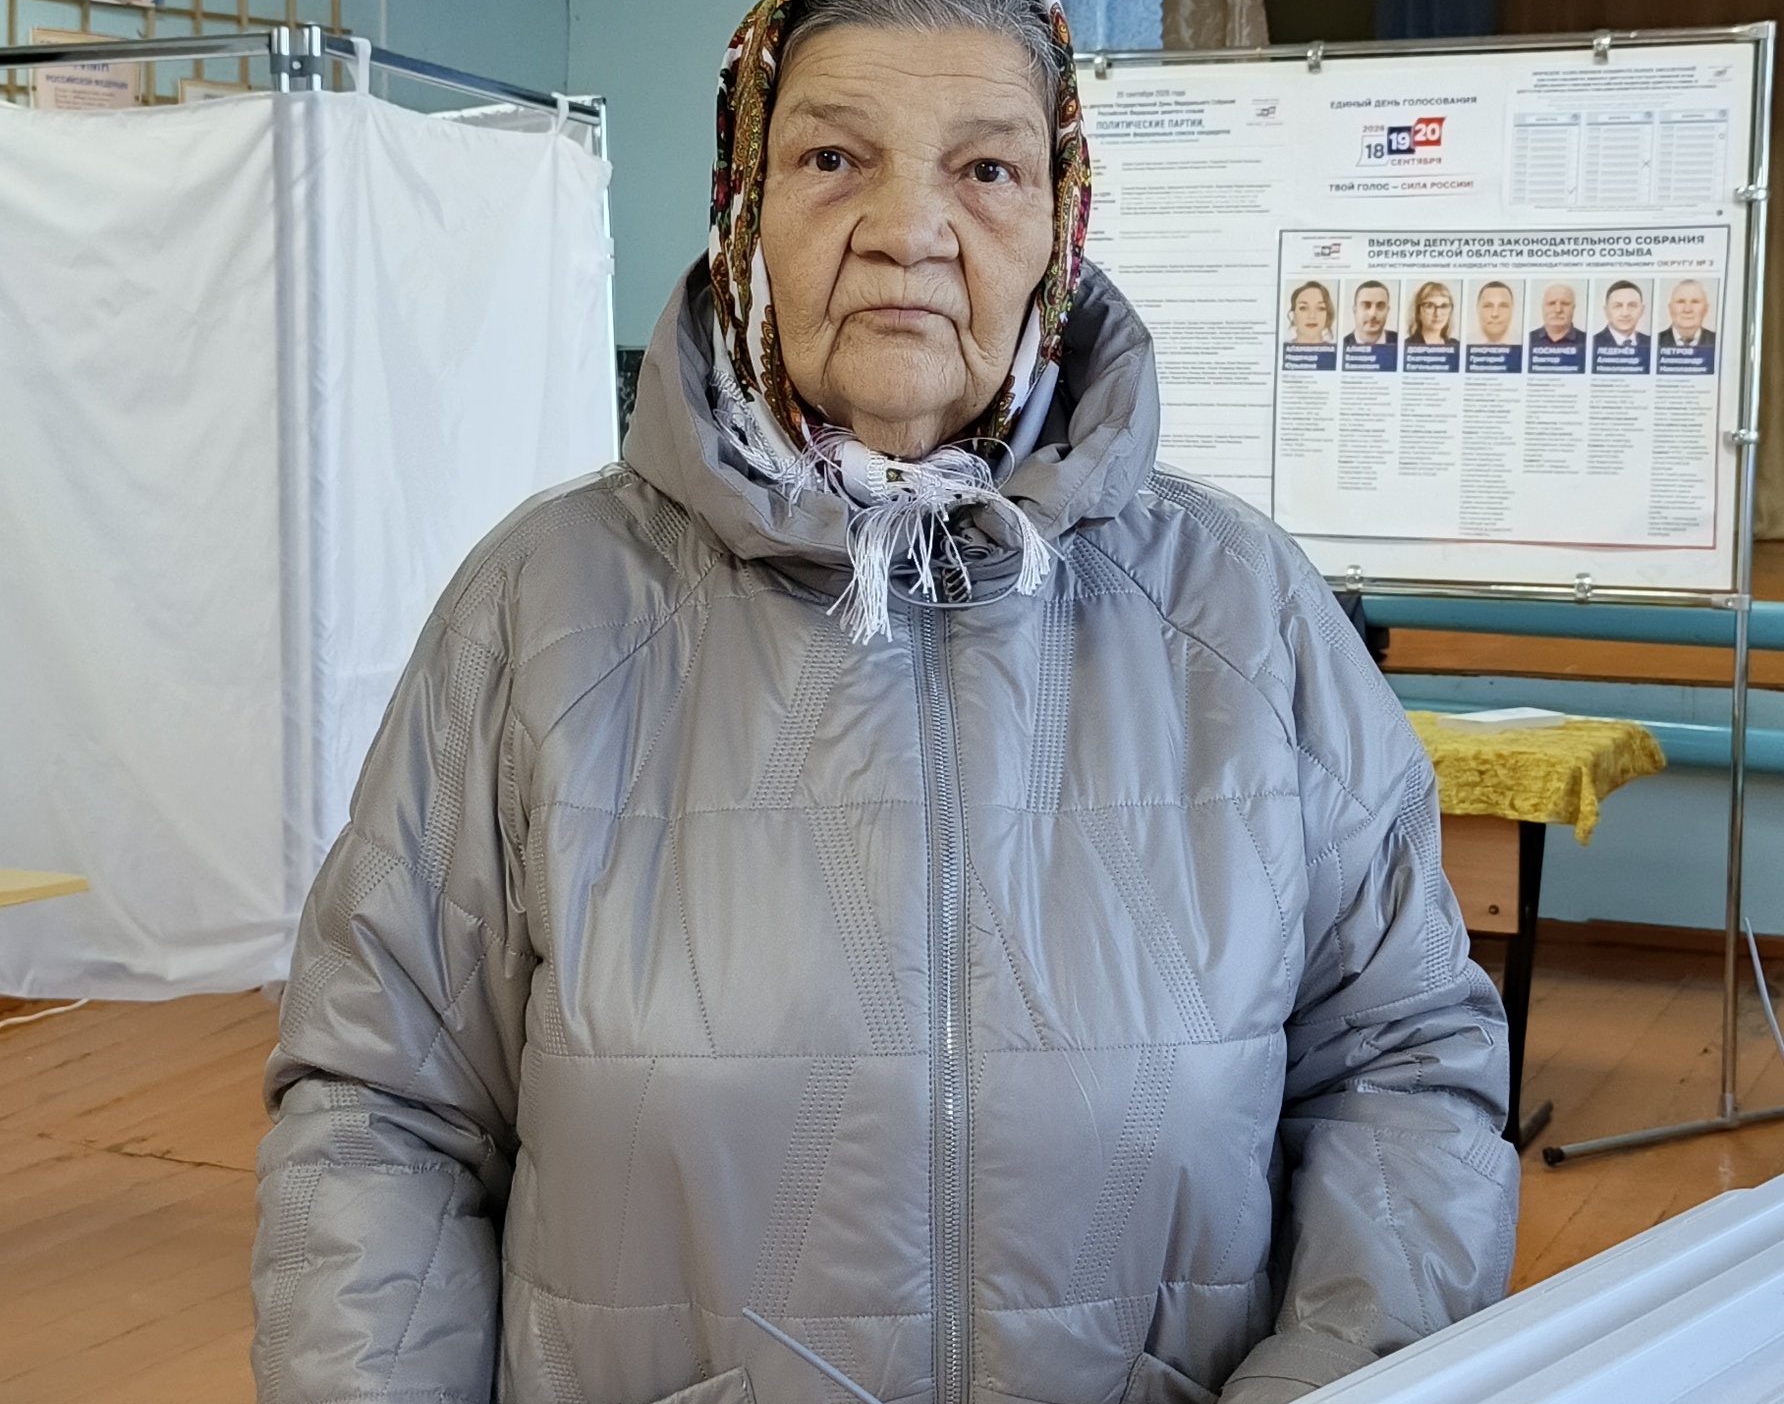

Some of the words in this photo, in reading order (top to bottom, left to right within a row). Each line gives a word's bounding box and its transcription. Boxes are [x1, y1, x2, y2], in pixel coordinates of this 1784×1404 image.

[1330, 98, 1371, 109] ЕДИНЫЙ
[1374, 98, 1400, 108] ДЕНЬ
[1403, 96, 1477, 106] ГОЛОСОВАНИЯ
[1096, 119, 1165, 130] ПОЛИТИЧЕСКИЕ
[1168, 118, 1205, 129] ПАРТИИ,
[1365, 144, 1384, 159] 18
[1389, 132, 1410, 150] 19
[1414, 123, 1440, 141] 20
[1391, 158, 1442, 166] СЕНТЯБРЯ
[1329, 182, 1354, 192] ТВОЙ
[1357, 183, 1389, 191] ГОЛОС
[1401, 182, 1427, 190] СИЛА
[1430, 180, 1474, 189] РОССИИ!
[1368, 238, 1420, 247] ВЫБОРЫ
[1423, 238, 1494, 248] ДЕПУТАТОВ
[1498, 236, 1632, 247] ЗАКОНОДАТЕЛЬНОГО
[1635, 235, 1704, 245] СОБРАНИЯ
[1368, 247, 1463, 258] ОРЕНБУРГСКОЙ
[1466, 249, 1524, 258] ОБЛАСТИ
[1527, 248, 1595, 258] ВОСЬМОГО
[1599, 247, 1652, 257] СОЗЫВА
[1660, 347, 1694, 356] ПЕТРОВ
